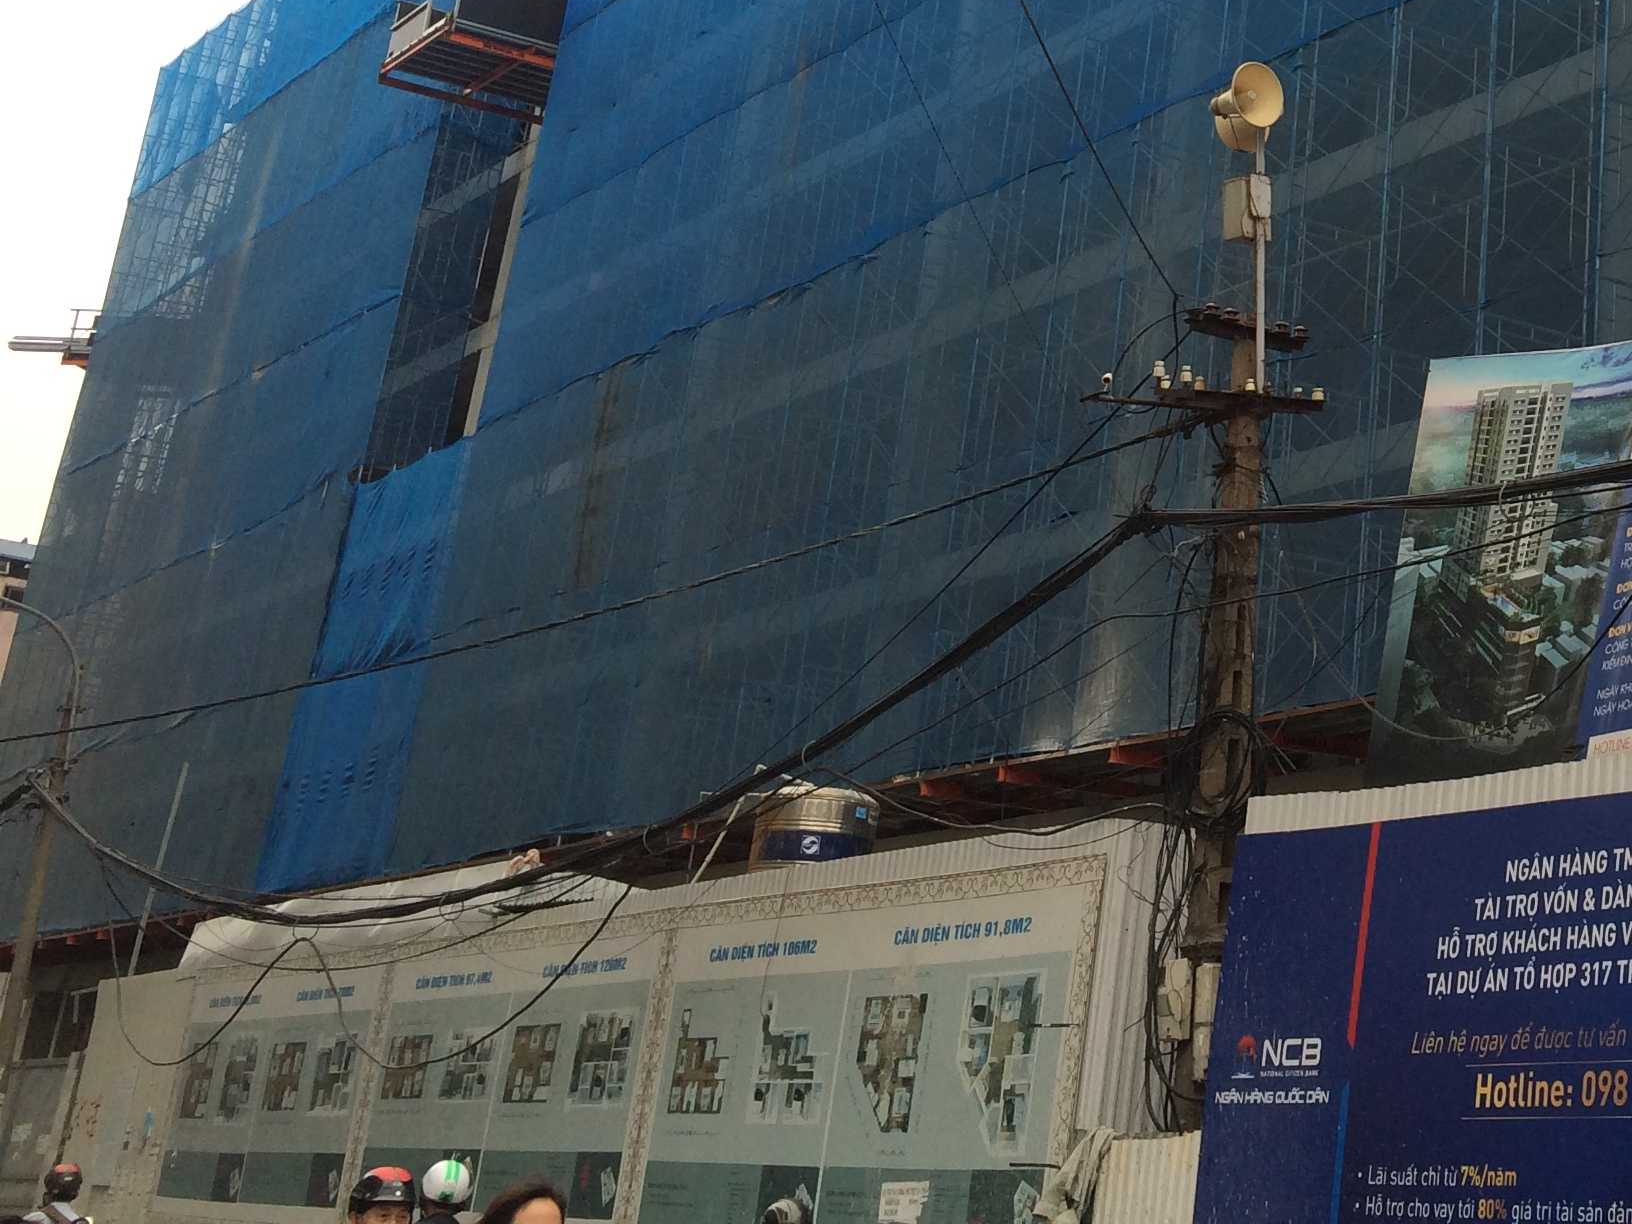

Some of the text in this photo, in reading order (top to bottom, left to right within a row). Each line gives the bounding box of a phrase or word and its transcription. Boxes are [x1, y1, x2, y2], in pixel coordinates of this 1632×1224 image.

[1505, 852, 1554, 884] NGÂN
[1558, 847, 1608, 877] HÀNG
[1475, 892, 1501, 921] TÀI
[1506, 891, 1540, 922] TRỢ
[1544, 882, 1579, 915] VỐN
[1583, 888, 1596, 912] &
[894, 916, 1033, 947] CĂN DIỆN TÍCH 91,8M2
[1437, 926, 1461, 960] HỖ
[1465, 932, 1498, 962] TRỢ
[1502, 923, 1562, 955] KHÁCH
[1566, 919, 1617, 951] HÀNG
[1427, 972, 1452, 1001] TẠI
[1456, 967, 1482, 999] DỰ
[1483, 963, 1508, 993] ÁN
[1514, 956, 1536, 991] TỔ
[1540, 962, 1577, 994] HỢP
[1580, 960, 1613, 987] 317
[1261, 1037, 1322, 1067] NCB
[1411, 1031, 1444, 1055] Liên
[1447, 1029, 1467, 1057] hệ
[1470, 1033, 1507, 1058] ngay
[1511, 1021, 1533, 1050] để
[1534, 1025, 1573, 1054] được
[1577, 1028, 1595, 1049] tư
[1599, 1018, 1627, 1047] vấn
[1215, 1086, 1330, 1104] NGÂN HÀNG QUỐC DÂN
[1475, 1071, 1574, 1109] Hotline:
[1581, 1069, 1629, 1108] 098
[1368, 1163, 1518, 1189] Lãi suất chỉ từ 7%/năm
[1365, 1192, 1384, 1218] Hỗ
[1386, 1197, 1405, 1219] trợ
[1407, 1197, 1430, 1218] cho
[1433, 1204, 1456, 1224] vay
[1458, 1199, 1475, 1219] tới
[1477, 1199, 1508, 1220] 80%
[1511, 1199, 1532, 1224] giá
[1555, 1202, 1574, 1223] tài
[1577, 1200, 1603, 1224] sản
